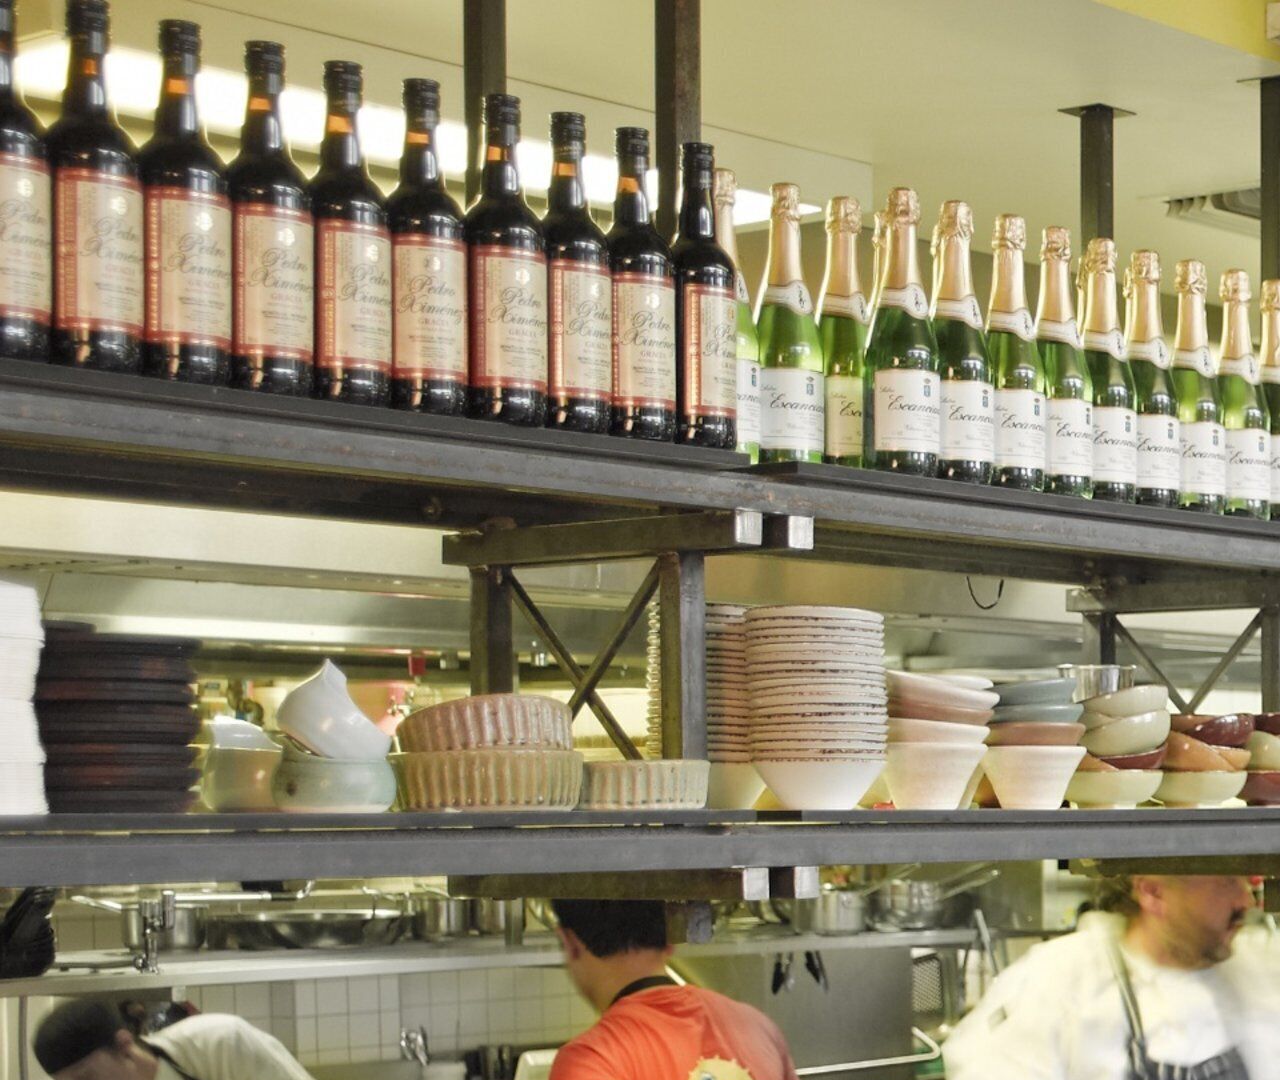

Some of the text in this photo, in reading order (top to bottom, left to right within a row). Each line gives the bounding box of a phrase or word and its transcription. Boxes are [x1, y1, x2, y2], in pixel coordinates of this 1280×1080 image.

[261, 248, 308, 272] Pedro
[409, 274, 455, 297] Pedro
[499, 286, 541, 309] Pedro
[631, 310, 671, 331] Pedro
